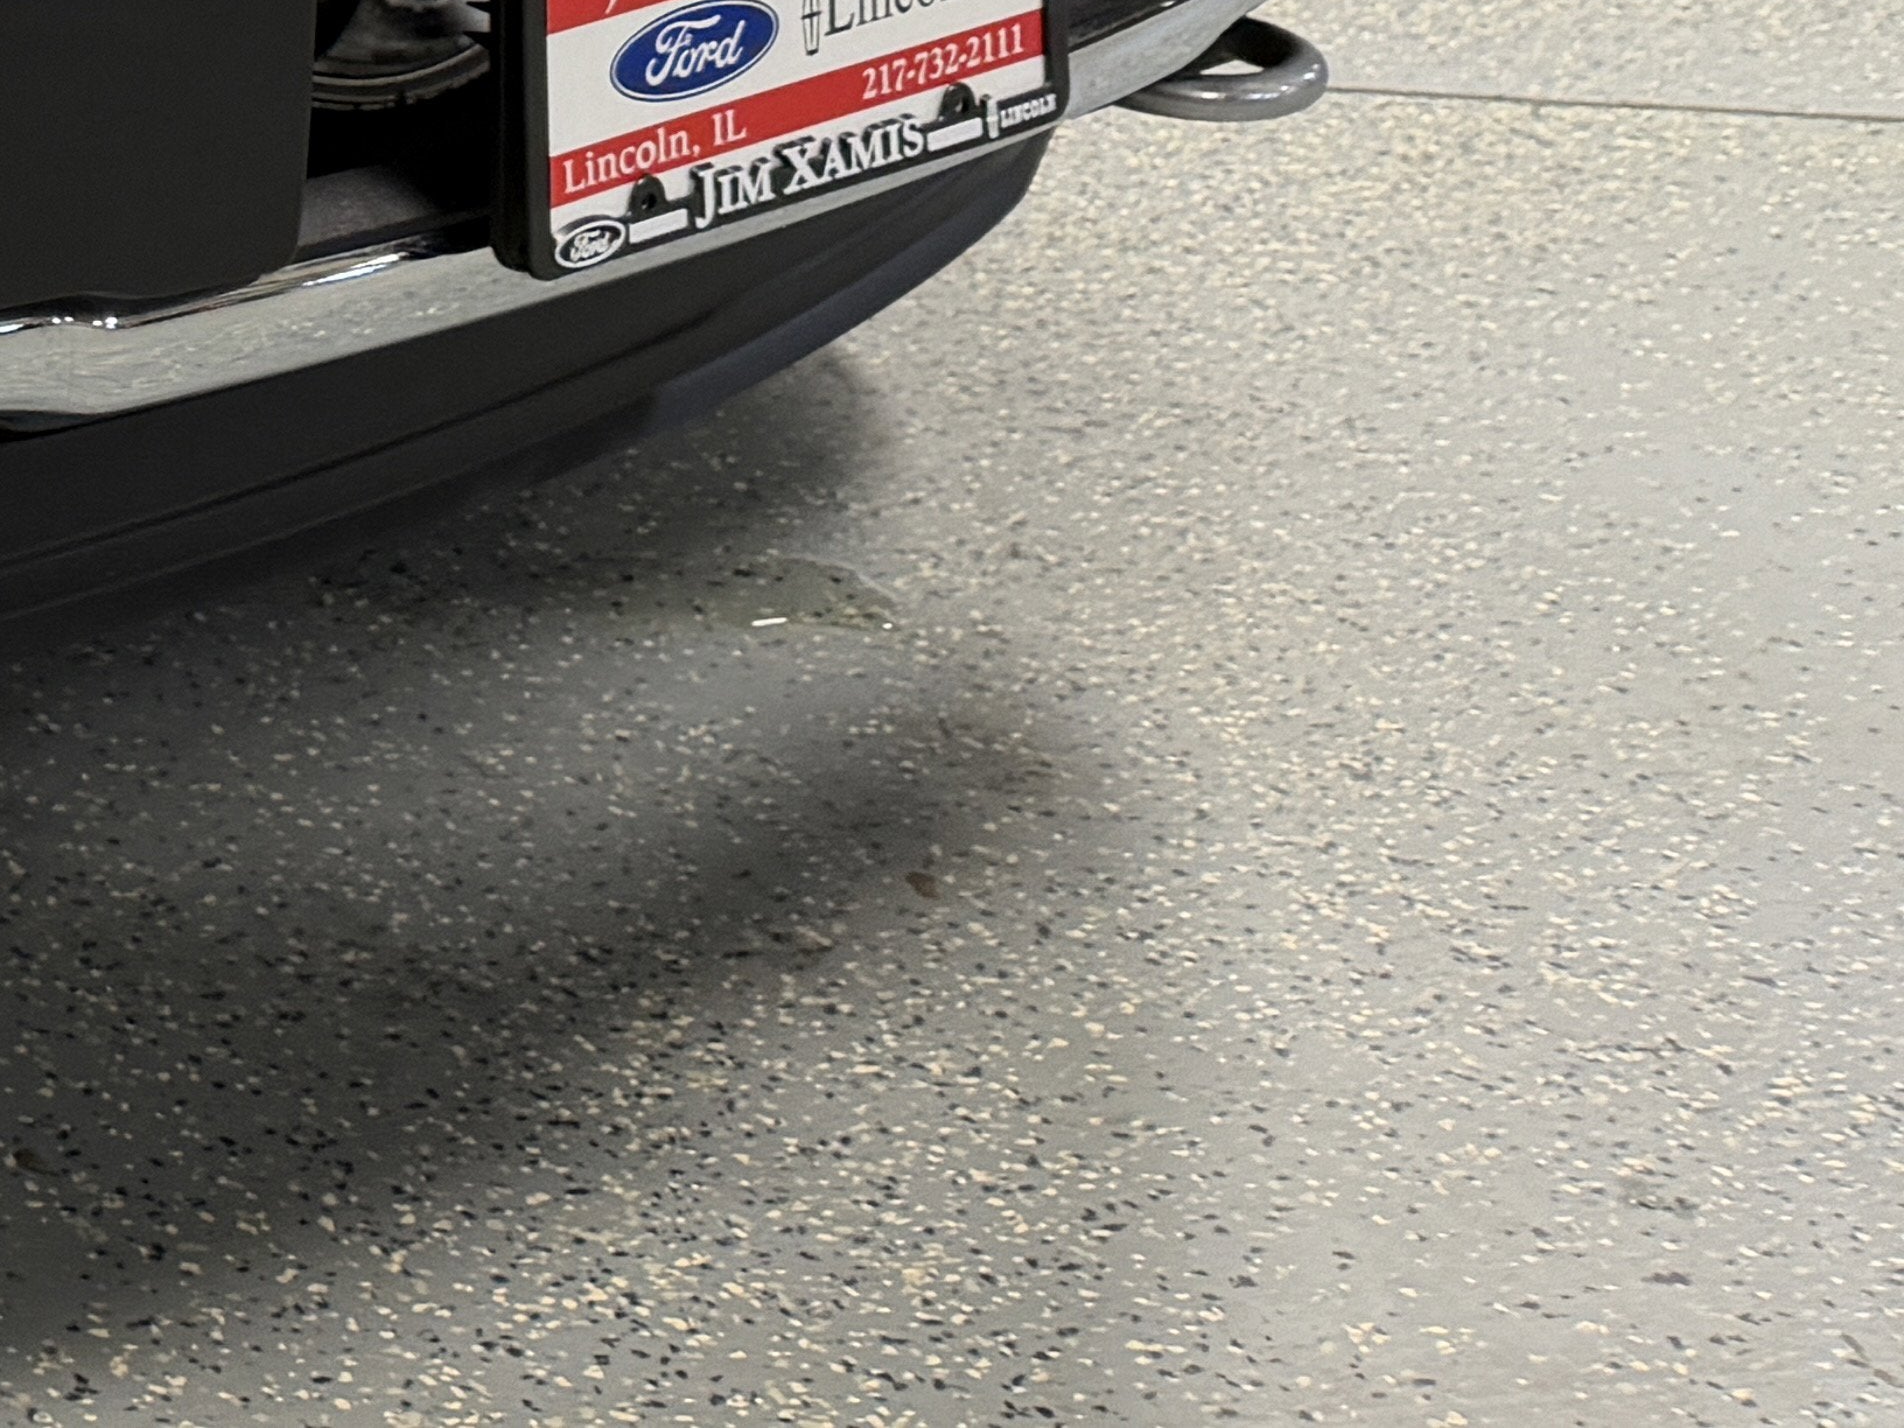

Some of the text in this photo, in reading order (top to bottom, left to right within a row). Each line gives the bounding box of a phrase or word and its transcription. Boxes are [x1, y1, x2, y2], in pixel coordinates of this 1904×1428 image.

[645, 14, 746, 87] Ford
[861, 23, 1025, 101] 217-732-2111
[563, 108, 747, 194] Lincoln, IL
[694, 116, 925, 230] JIM XAMIS
